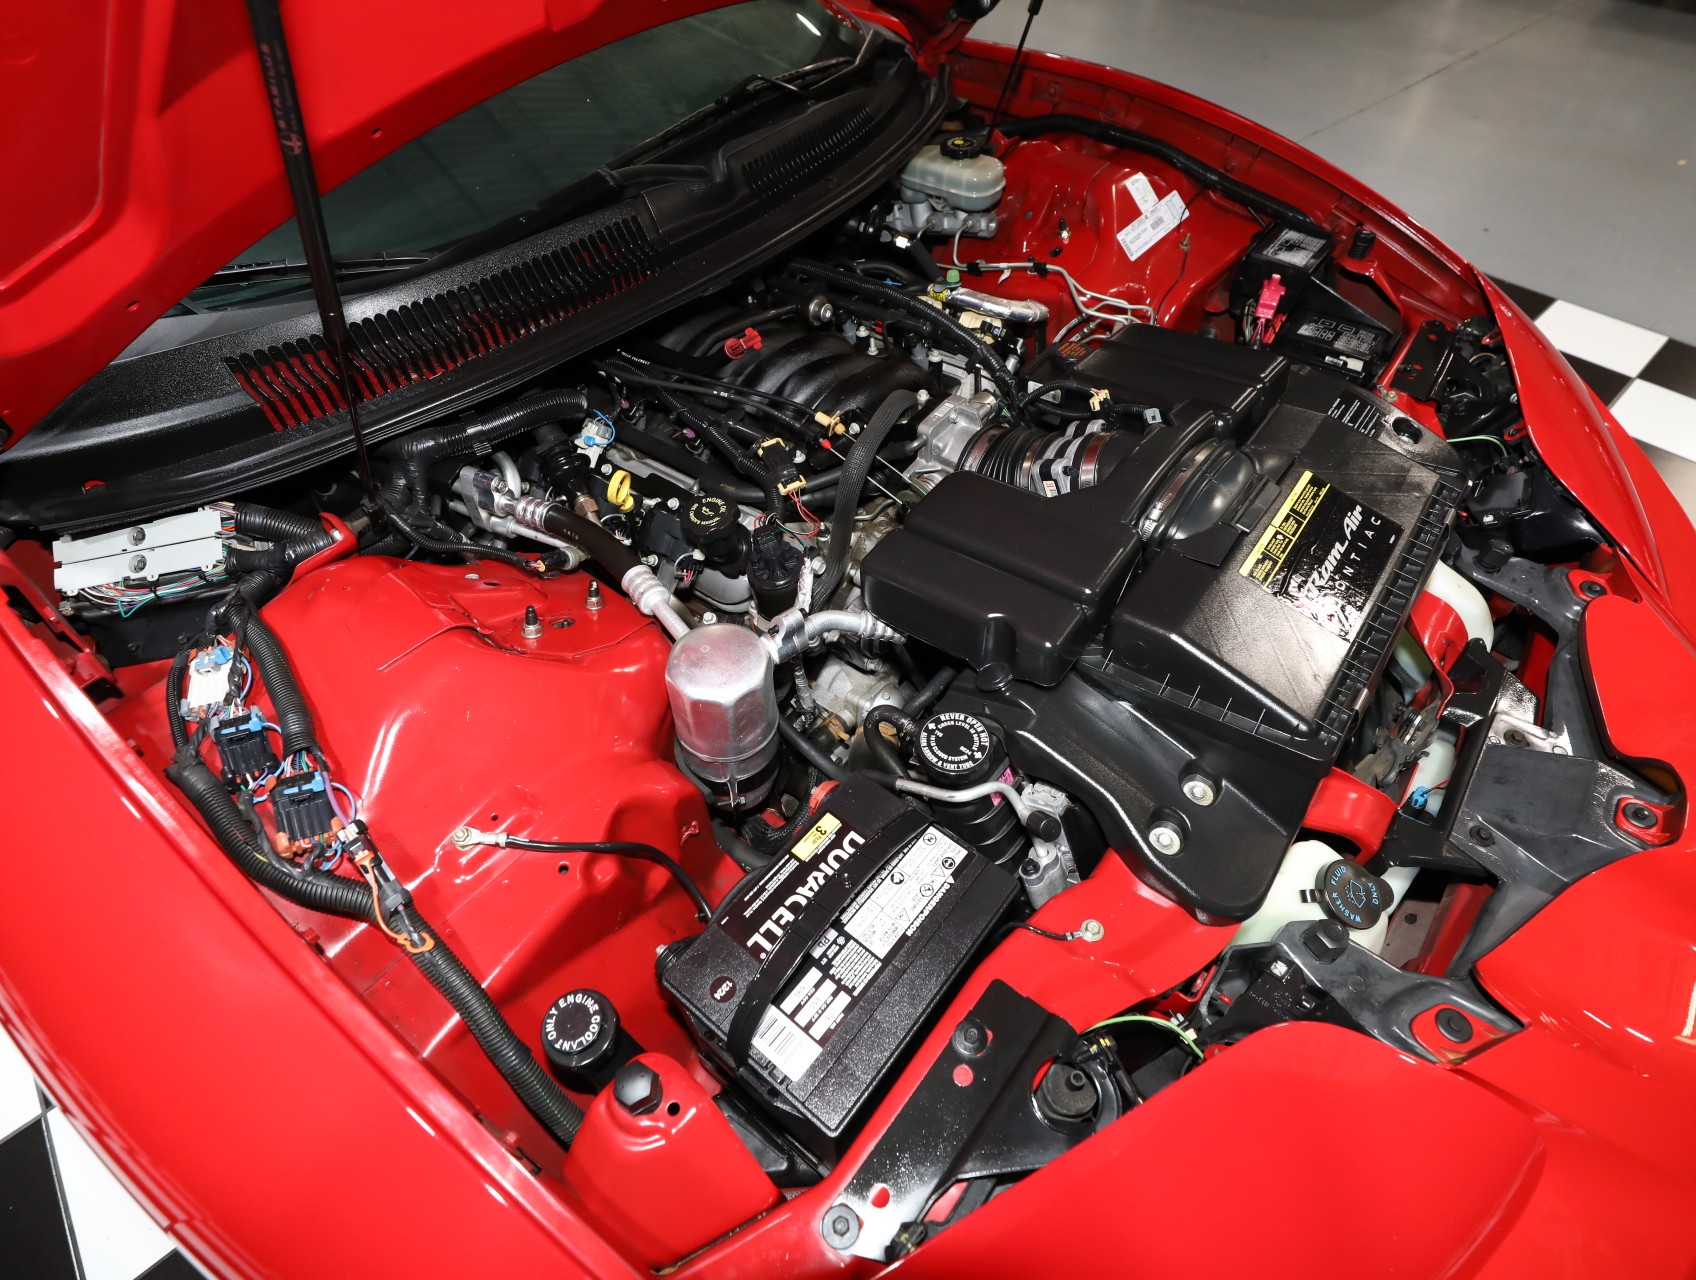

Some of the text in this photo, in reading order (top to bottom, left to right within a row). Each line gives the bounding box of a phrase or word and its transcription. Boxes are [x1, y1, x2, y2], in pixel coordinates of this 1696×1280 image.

[702, 497, 725, 506] ENGINE
[701, 517, 720, 525] MANUAL
[1304, 540, 1348, 598] Ram
[1343, 505, 1362, 540] Air
[1334, 516, 1381, 592] ONTIAC
[937, 720, 954, 728] CHECK
[955, 720, 970, 729] LEVEL
[966, 717, 983, 732] OPEN
[979, 732, 987, 746] HOT
[922, 746, 938, 763] ARROW
[942, 761, 957, 769] VENT
[958, 760, 974, 769] TUBE
[932, 745, 948, 759] CLOSED
[814, 824, 827, 836] 3
[745, 830, 865, 959] DURACELL
[1331, 865, 1379, 923] WASHER FLUID ONLY
[816, 935, 830, 949] Pb
[711, 978, 734, 1000] 12/24
[546, 993, 600, 1051] ENGINE COOLANT ONLY
